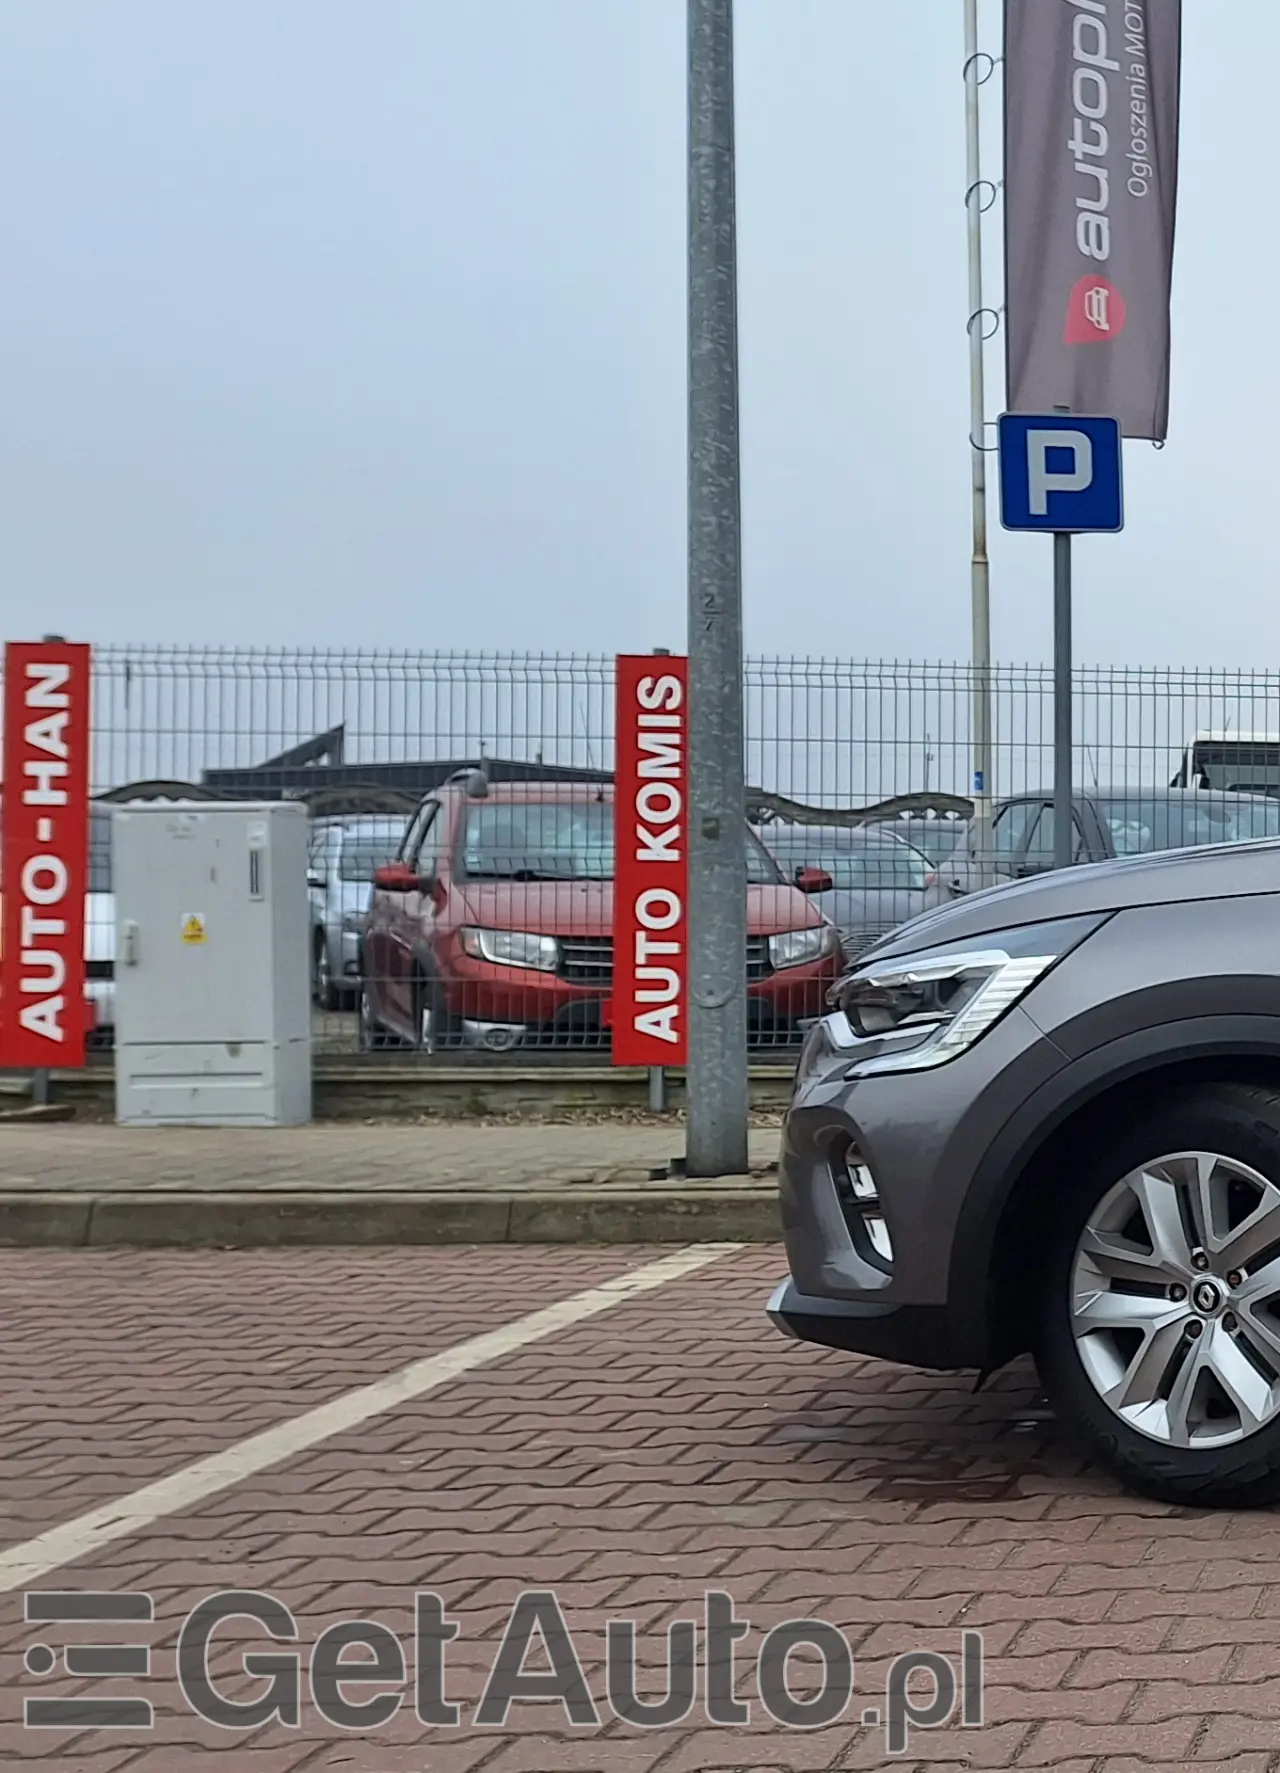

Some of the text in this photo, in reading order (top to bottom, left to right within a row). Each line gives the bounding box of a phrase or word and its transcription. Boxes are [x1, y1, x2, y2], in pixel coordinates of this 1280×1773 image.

[1125, 63, 1153, 198] Ogłoszenia
[1026, 428, 1094, 516] P
[634, 675, 683, 1043] AUTO KOMIS
